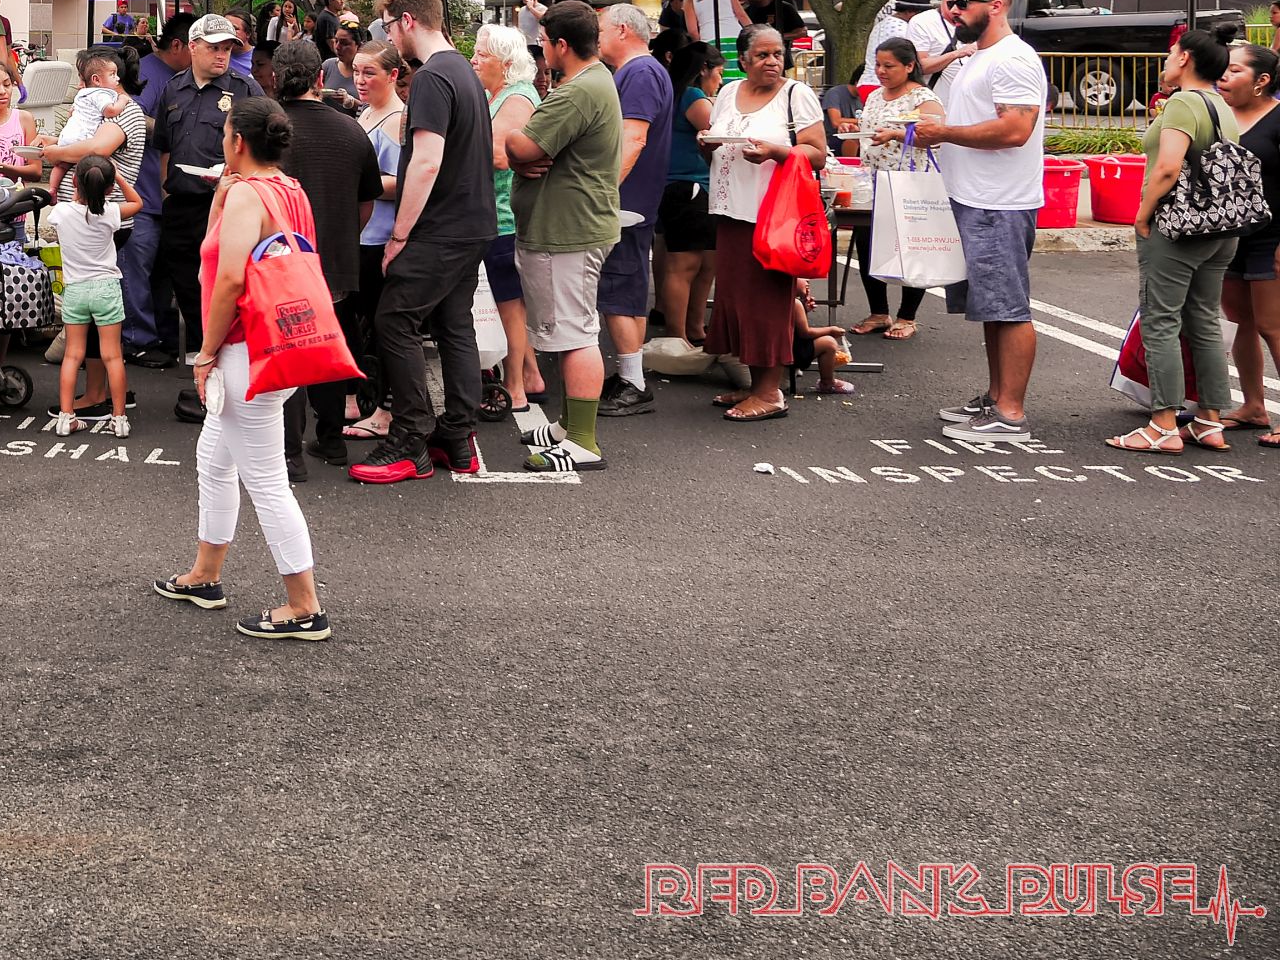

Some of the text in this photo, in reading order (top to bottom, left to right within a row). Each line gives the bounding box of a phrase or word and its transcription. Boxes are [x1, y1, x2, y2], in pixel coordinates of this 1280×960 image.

[298, 339, 307, 348] OF
[308, 335, 322, 344] RED
[870, 439, 1065, 455] FIRE
[780, 465, 1266, 484] INSPECTOR
